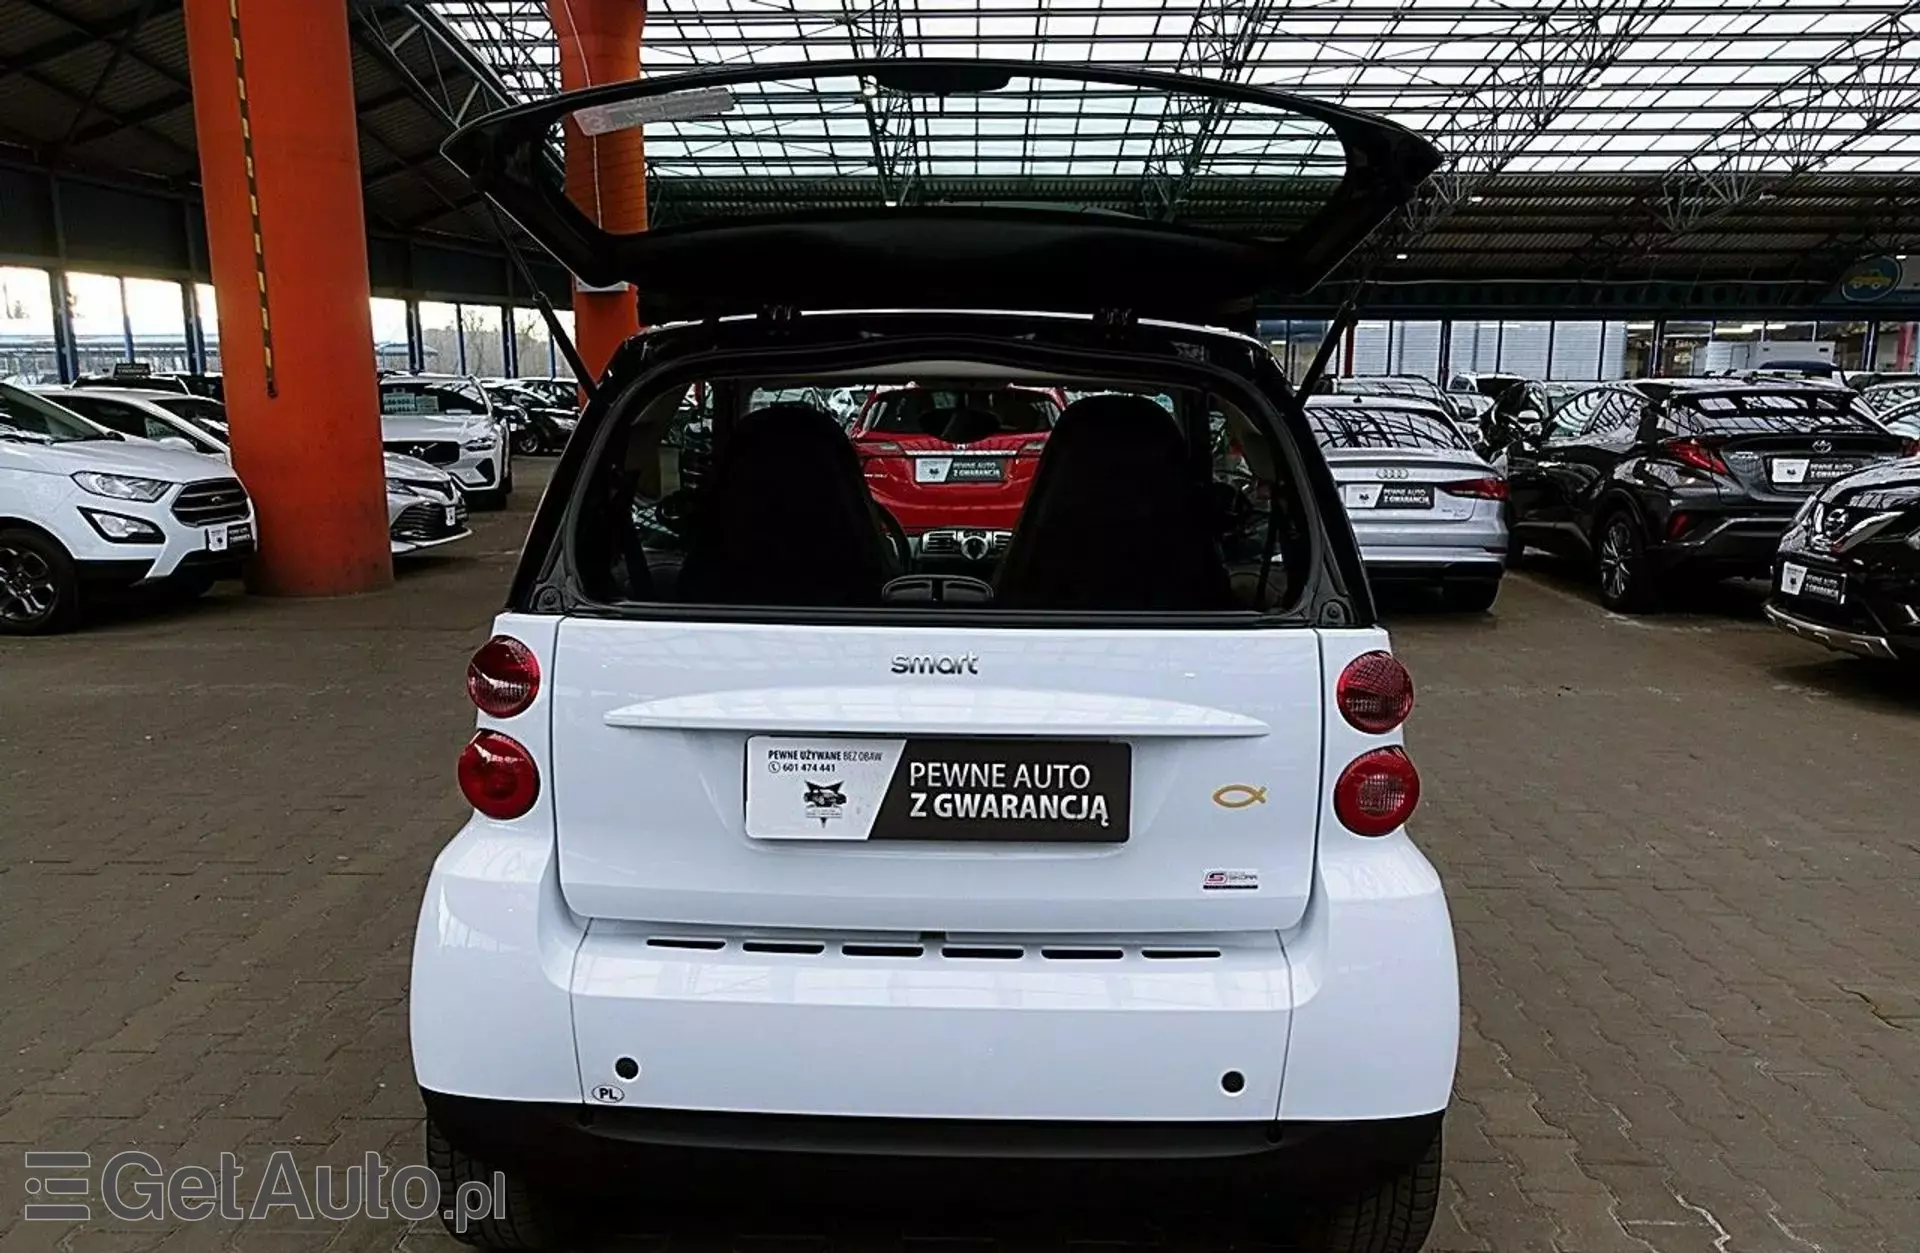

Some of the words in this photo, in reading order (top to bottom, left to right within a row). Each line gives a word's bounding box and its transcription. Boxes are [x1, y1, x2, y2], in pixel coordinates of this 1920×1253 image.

[891, 651, 979, 675] smart
[768, 750, 798, 761] PEWNE
[800, 749, 842, 762] UŻYWANE
[843, 751, 857, 762] BEZ
[858, 752, 882, 762] OBAW
[782, 763, 798, 772] 601
[800, 763, 817, 772] 474
[819, 764, 836, 772] 441
[910, 762, 1006, 788] PEWNE
[1013, 763, 1091, 789] AUTO
[910, 793, 927, 818] Z
[933, 793, 1110, 827] GWARANCJĄ
[599, 1087, 618, 1100] PL
